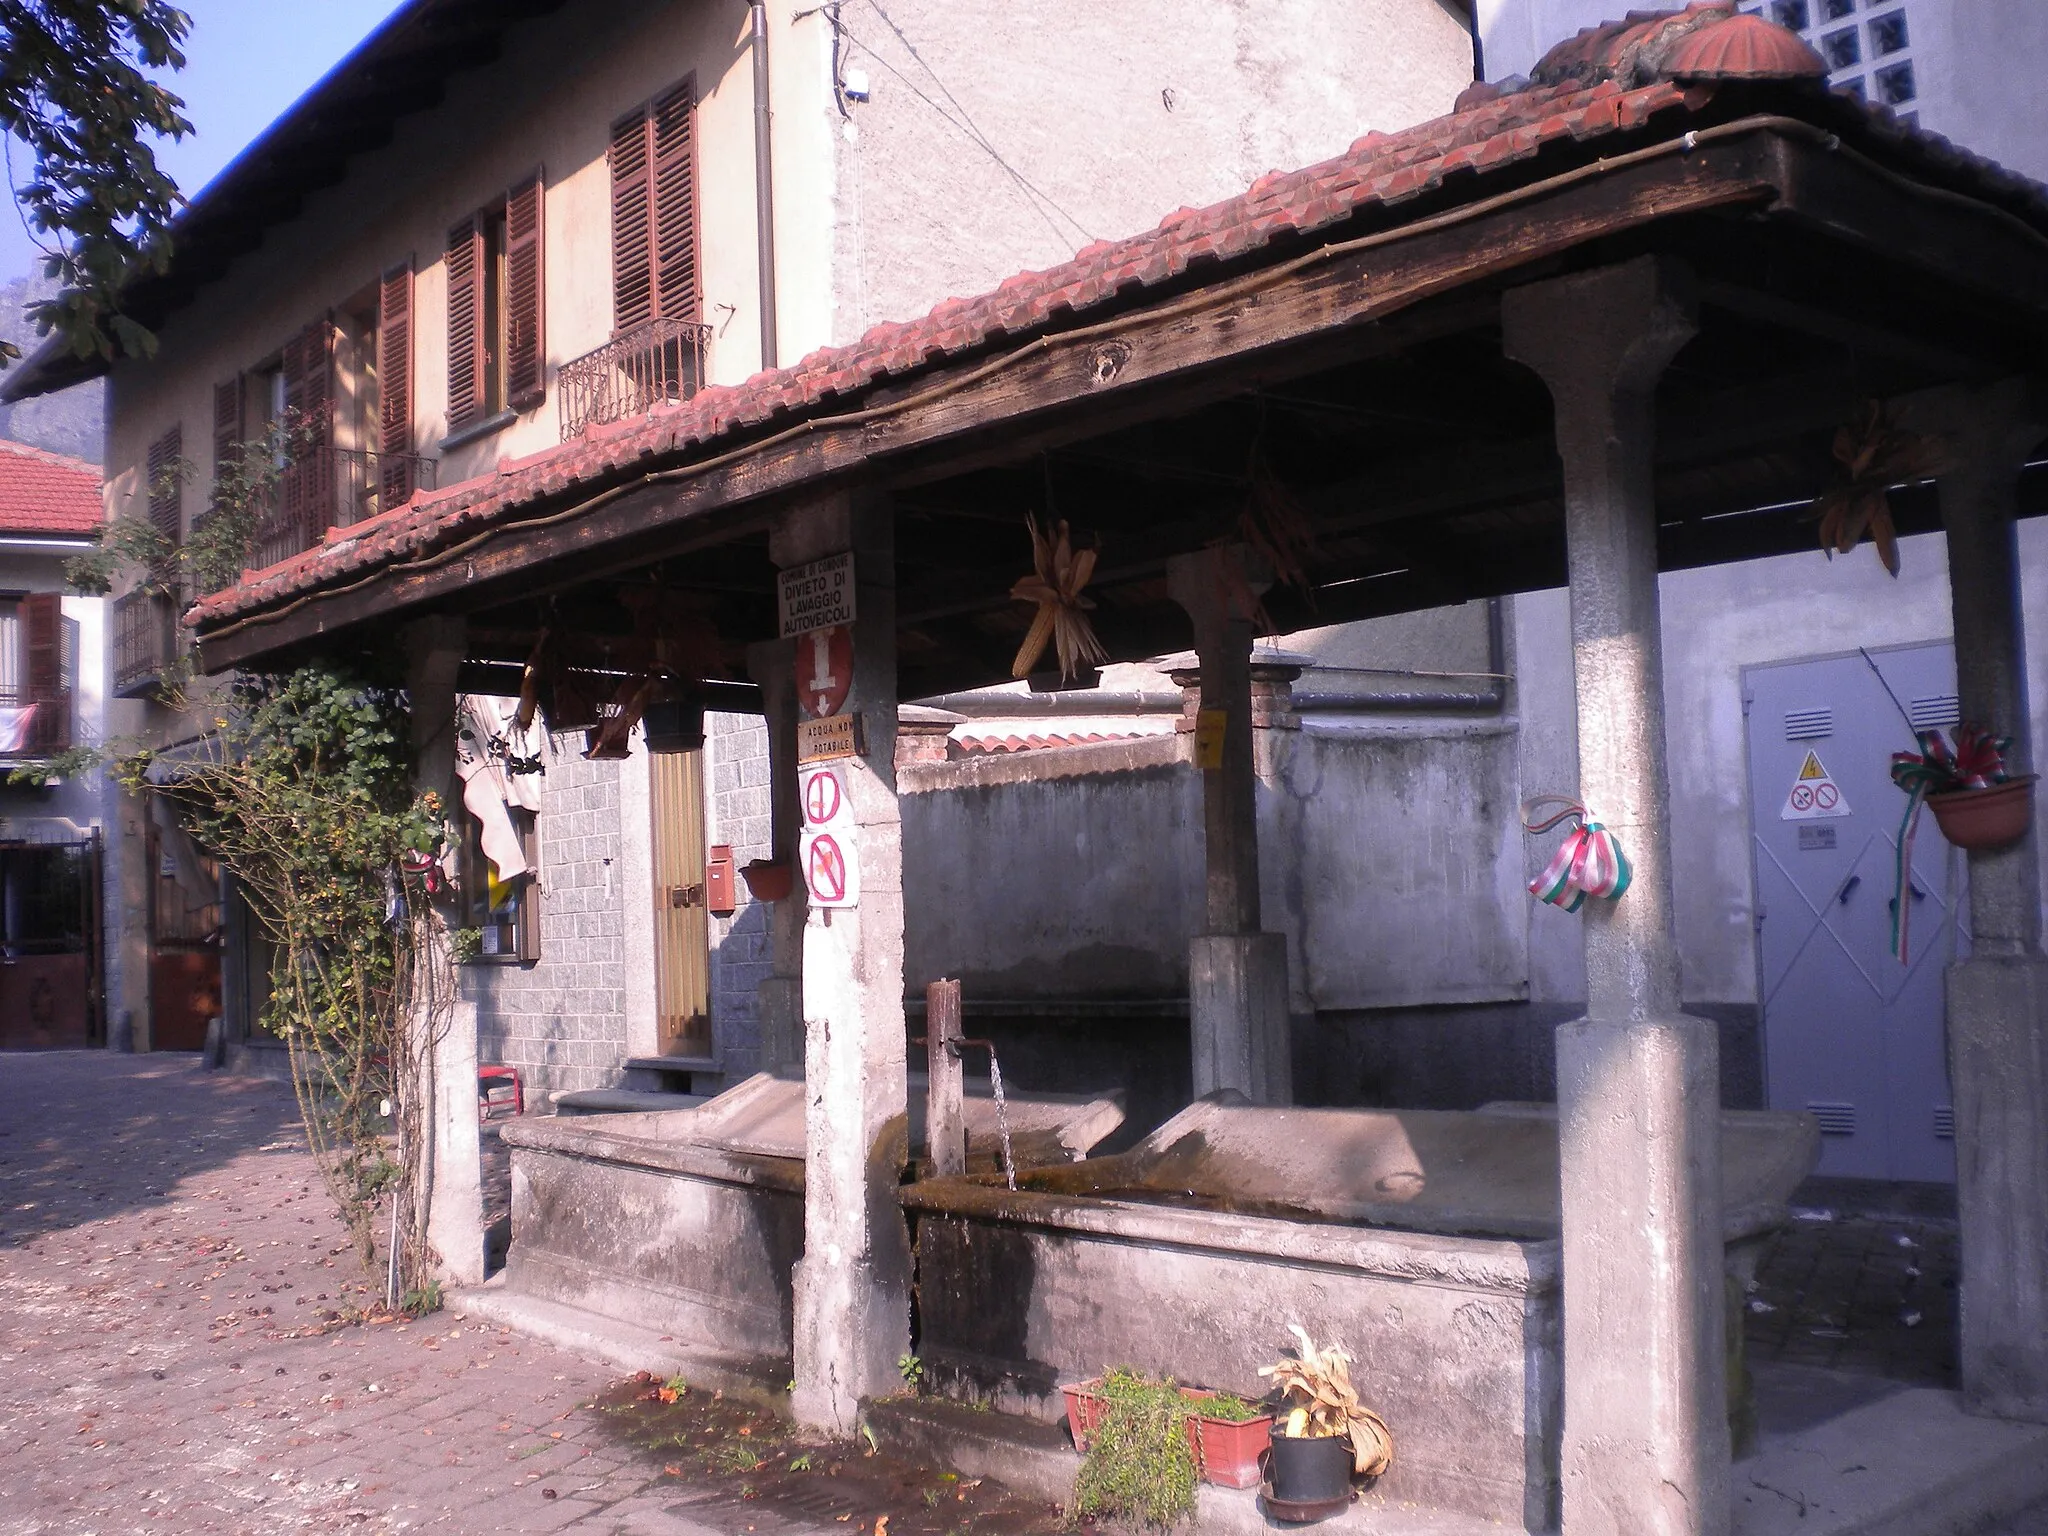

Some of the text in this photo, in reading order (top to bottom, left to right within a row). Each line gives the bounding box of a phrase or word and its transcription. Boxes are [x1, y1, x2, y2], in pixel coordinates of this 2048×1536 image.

[785, 571, 846, 601] DIVIETO DI
[789, 590, 842, 616] LAVAGGIO
[784, 604, 850, 635] AUTOVEICOLI
[808, 724, 833, 738] ACQUA
[814, 739, 849, 754] POTABILE
